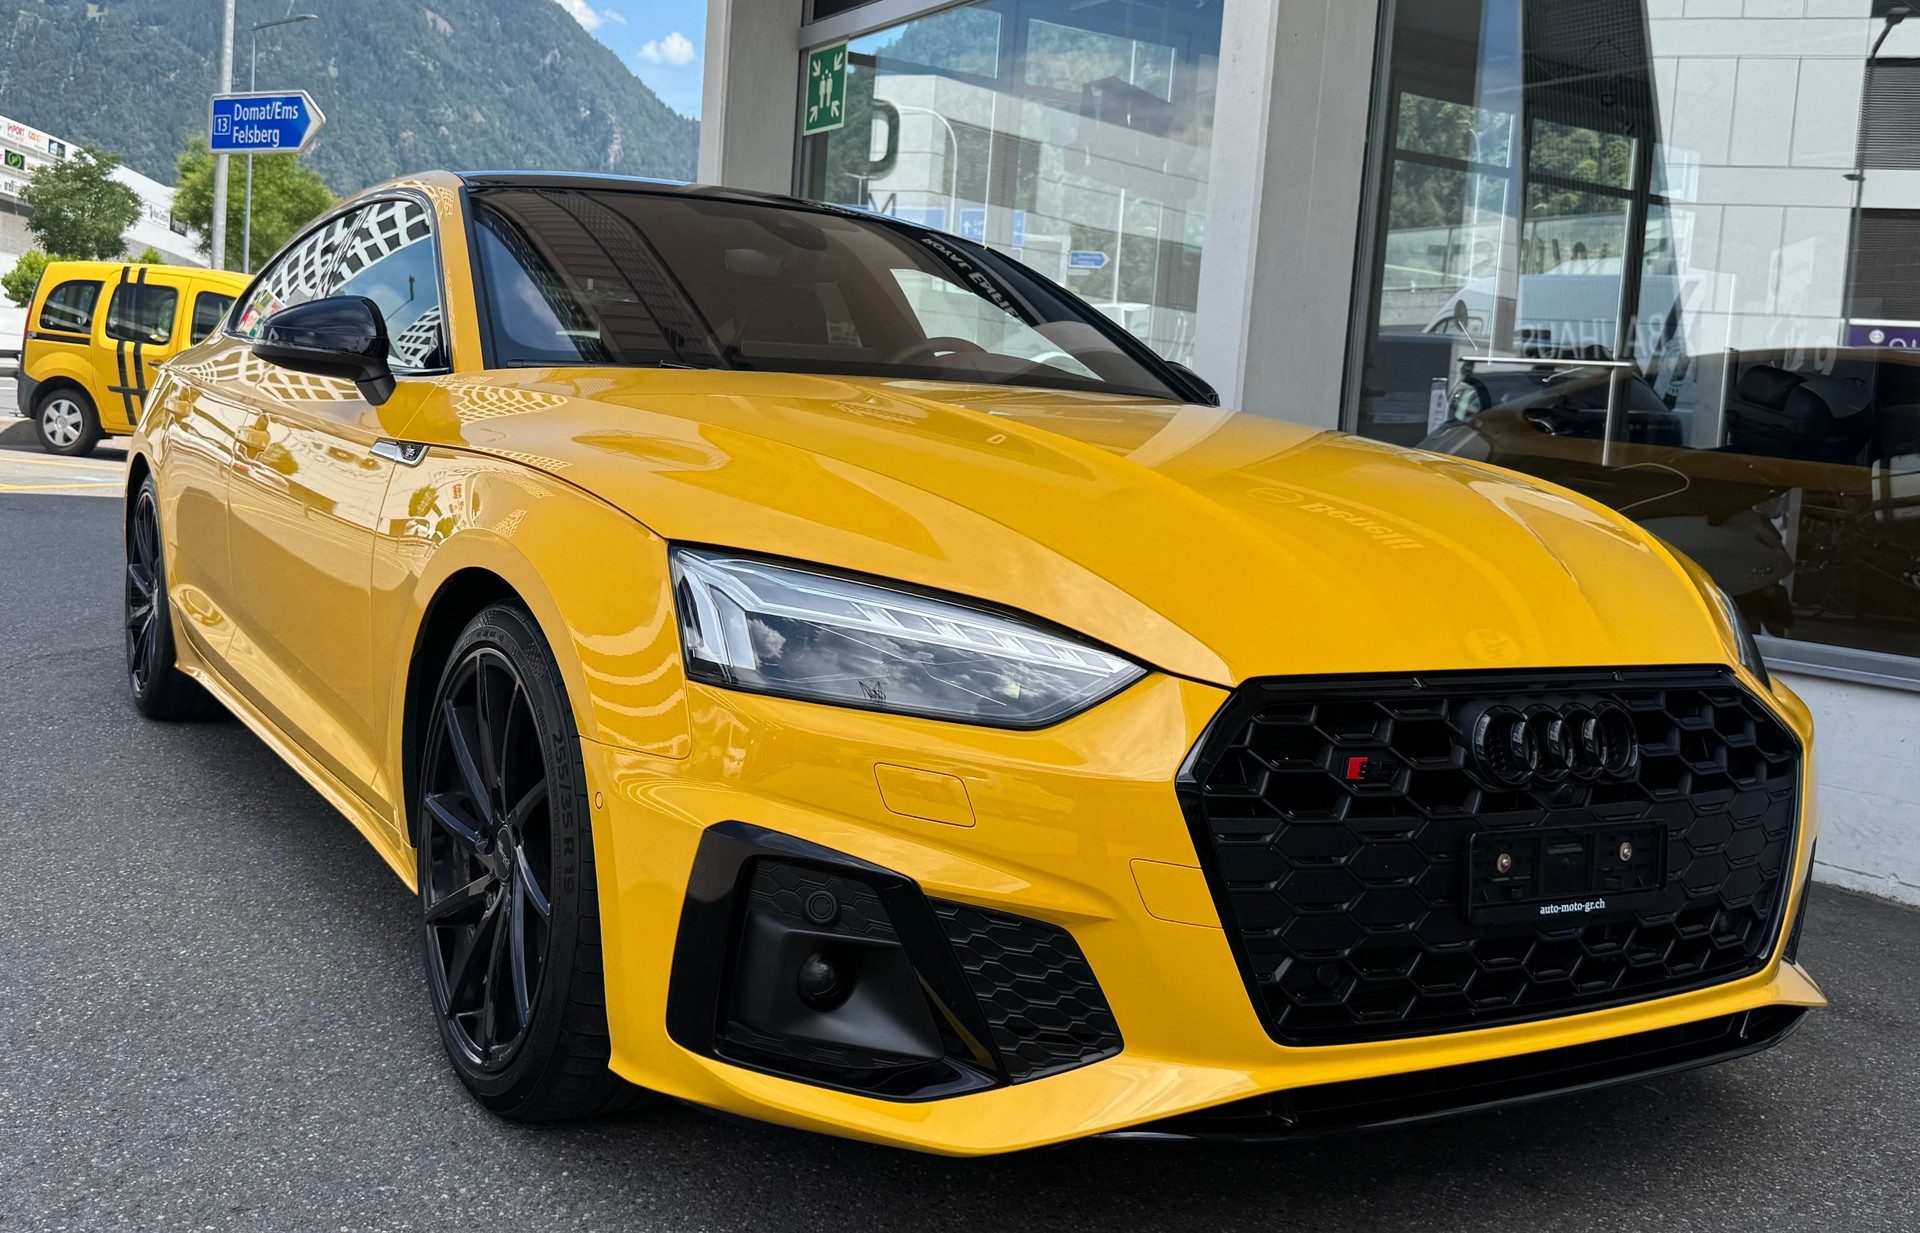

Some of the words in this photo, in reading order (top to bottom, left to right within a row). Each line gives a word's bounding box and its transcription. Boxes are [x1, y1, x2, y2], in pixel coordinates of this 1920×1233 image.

[234, 101, 299, 121] Domat/Ems
[217, 117, 228, 132] 13
[232, 124, 280, 148] Felsberg
[552, 728, 574, 829] 255/35
[563, 837, 574, 857] R
[563, 866, 575, 896] 19
[1540, 898, 1605, 914] auto-moto-gr.ch
